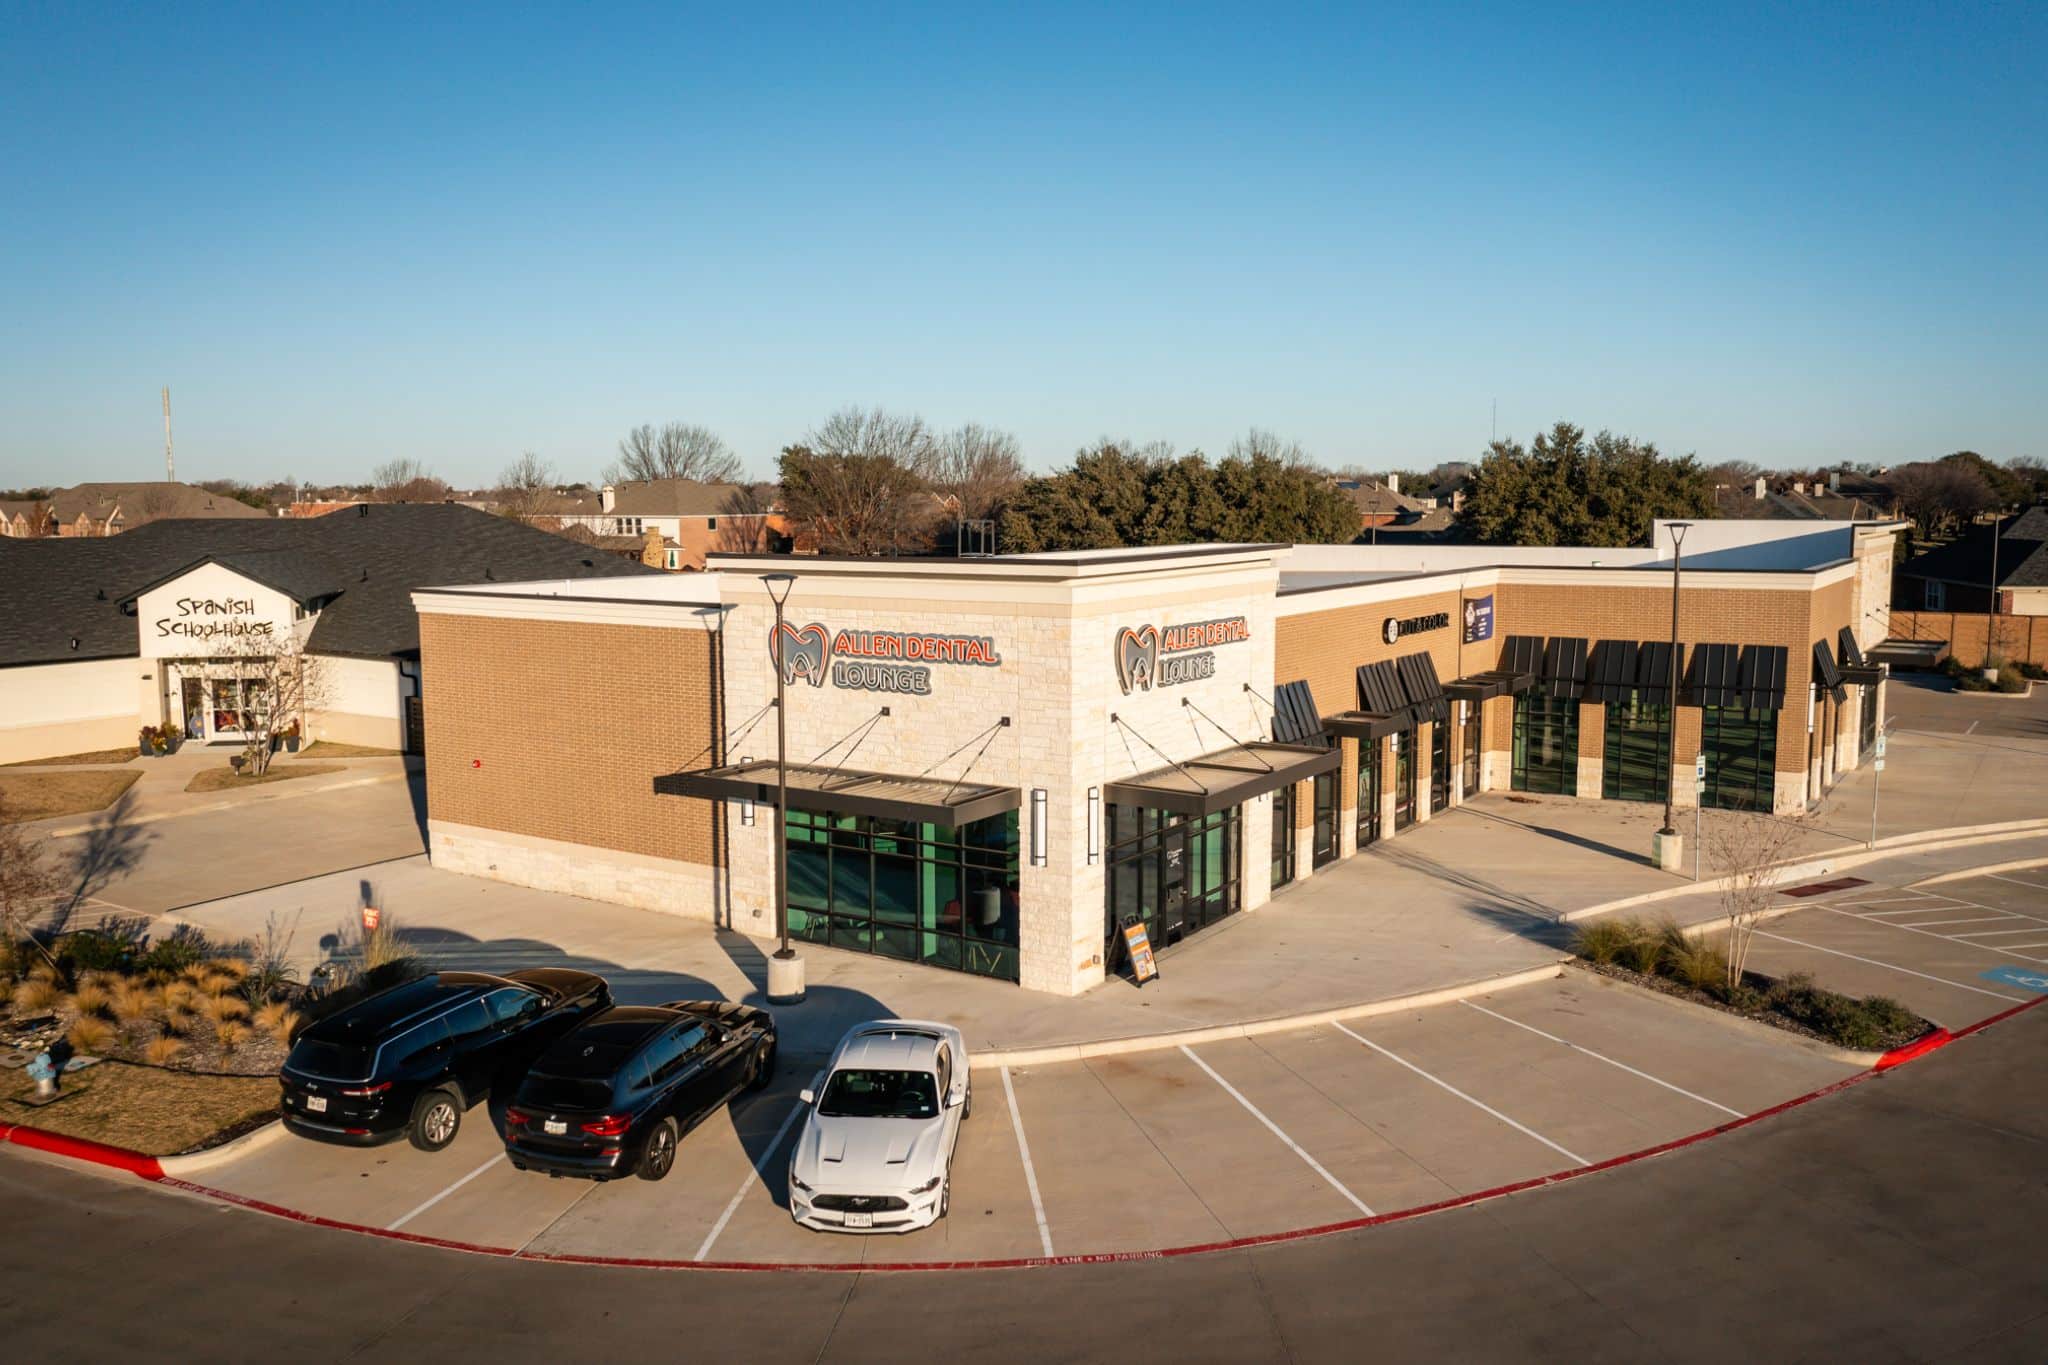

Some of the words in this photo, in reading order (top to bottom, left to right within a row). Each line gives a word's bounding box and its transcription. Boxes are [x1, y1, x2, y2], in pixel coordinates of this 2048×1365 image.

[156, 618, 273, 638] SCHOOLHOUSE
[1164, 627, 1205, 652] ALLEN
[1206, 619, 1251, 646] DENTAL
[834, 632, 902, 657] ALLEN
[906, 636, 998, 663] DENTAL
[834, 663, 930, 693] LOUNGE
[1163, 655, 1216, 683] LOUNGE
